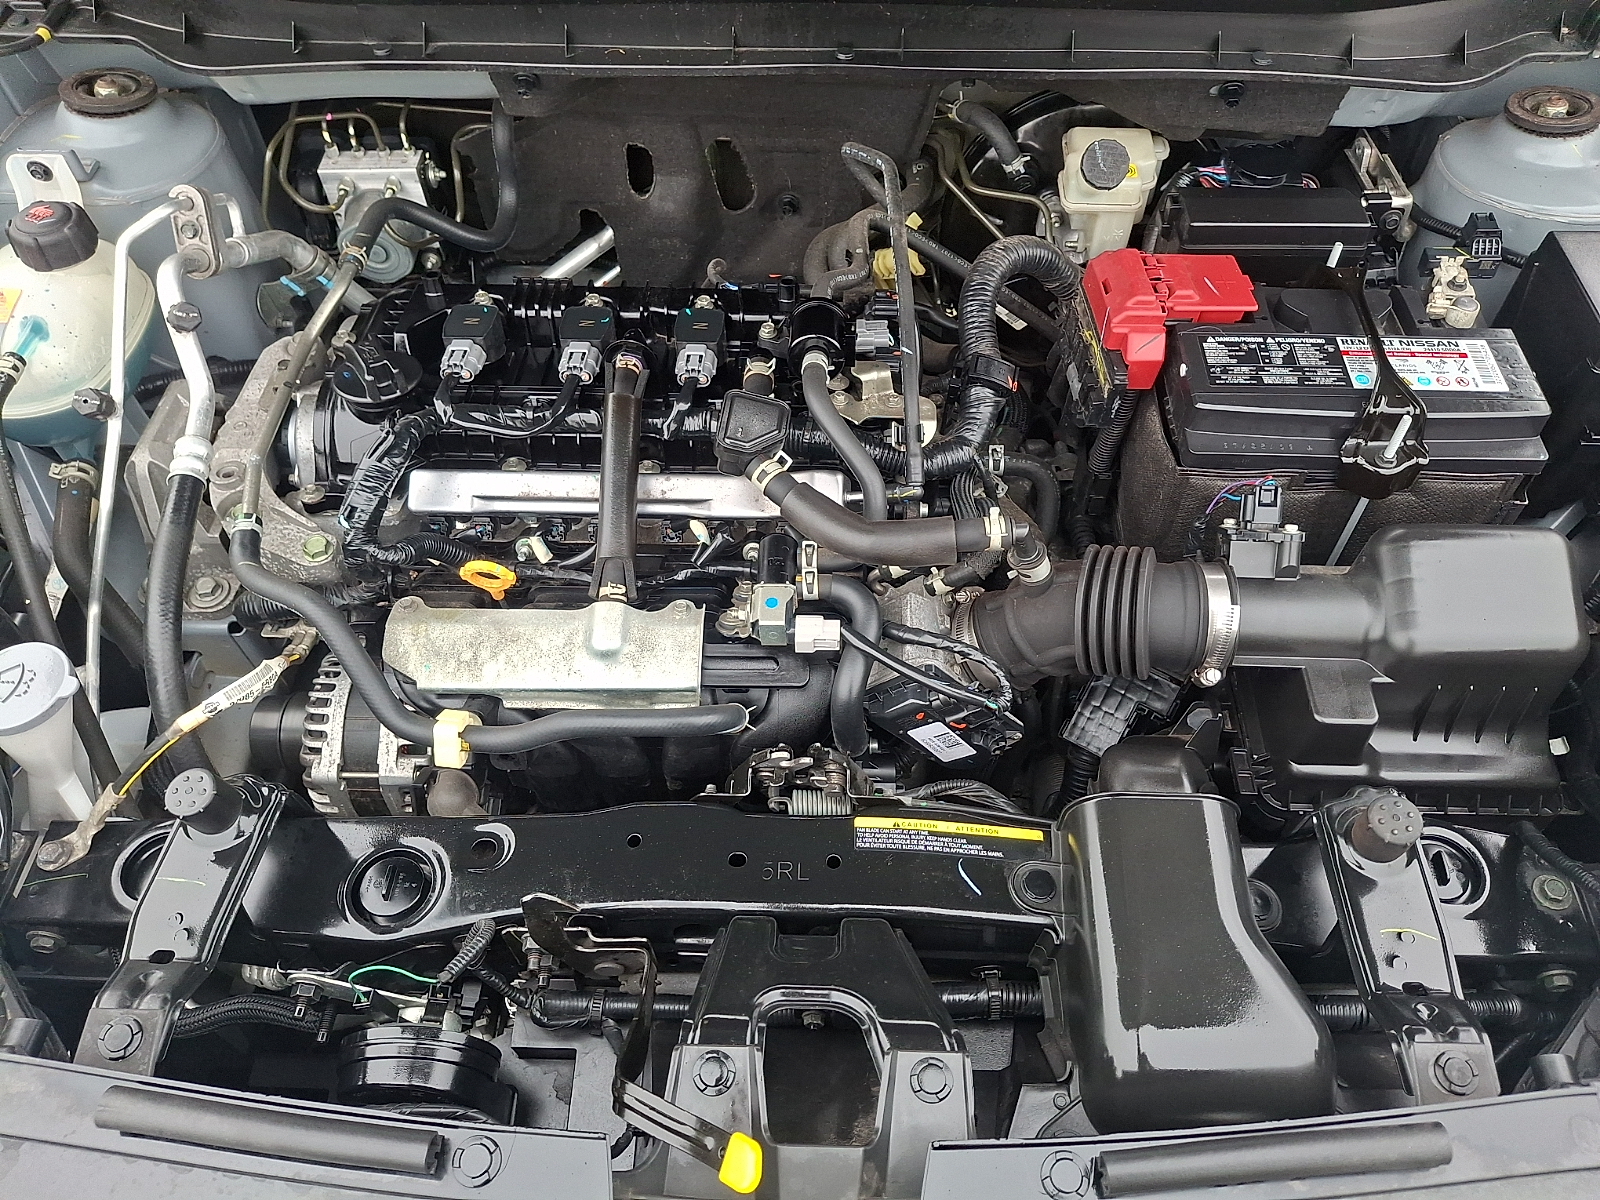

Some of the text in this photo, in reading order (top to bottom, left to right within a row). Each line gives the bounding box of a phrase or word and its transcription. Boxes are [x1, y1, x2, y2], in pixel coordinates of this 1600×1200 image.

[1341, 338, 1460, 348] RENLT NISSAN
[901, 821, 938, 829] CAUTION
[955, 826, 1000, 835] ATTENTION
